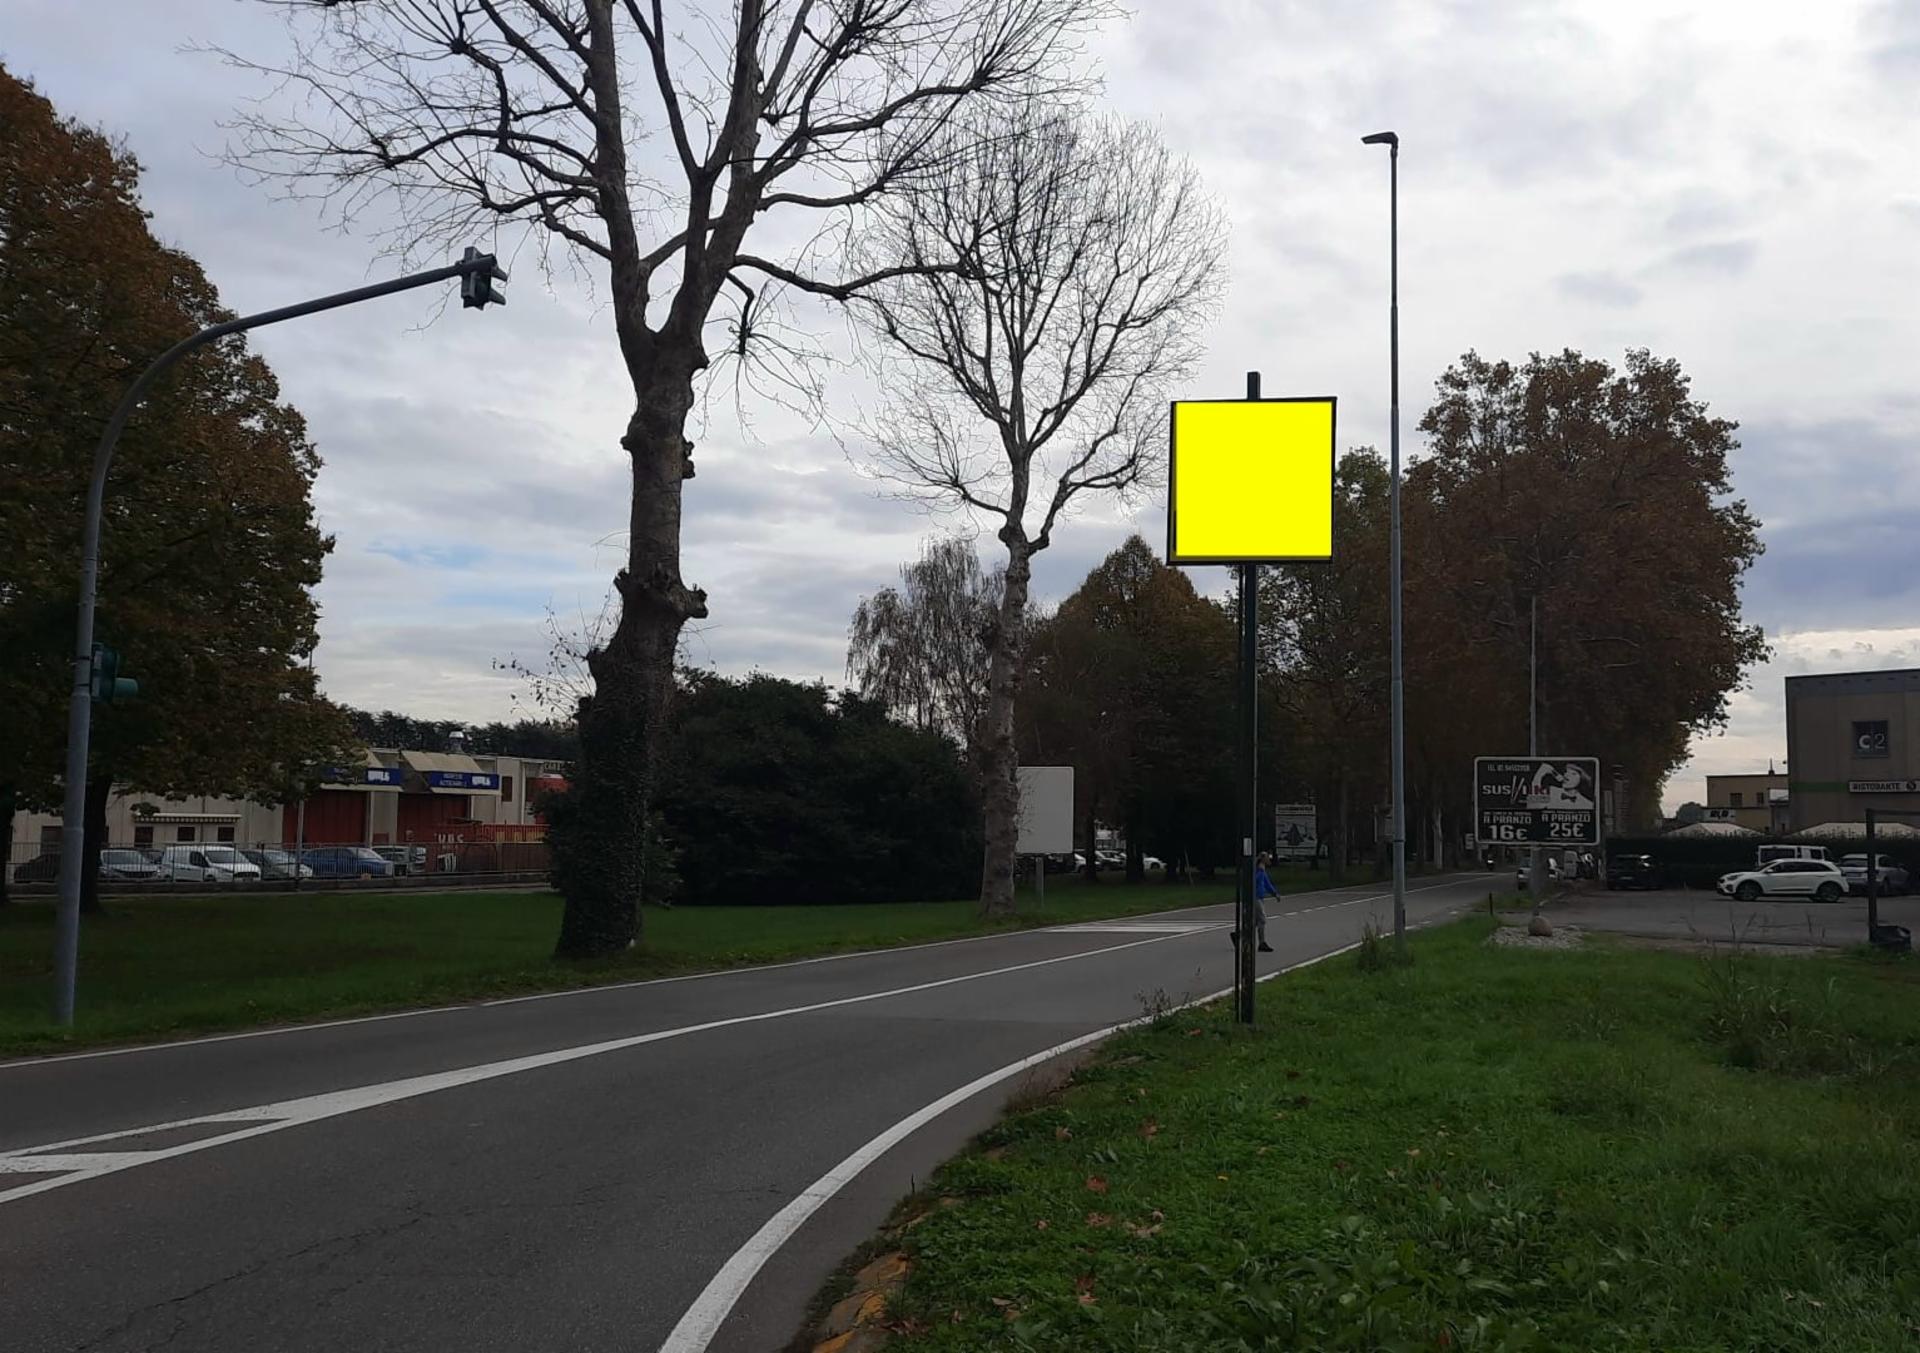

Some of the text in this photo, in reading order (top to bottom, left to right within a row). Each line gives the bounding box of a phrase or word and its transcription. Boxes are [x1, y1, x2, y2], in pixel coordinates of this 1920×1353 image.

[1493, 815, 1532, 825] PRANZO
[1541, 813, 1591, 823] A PRANZO
[1488, 825, 1528, 840] 16€
[1550, 823, 1585, 838] 25€
